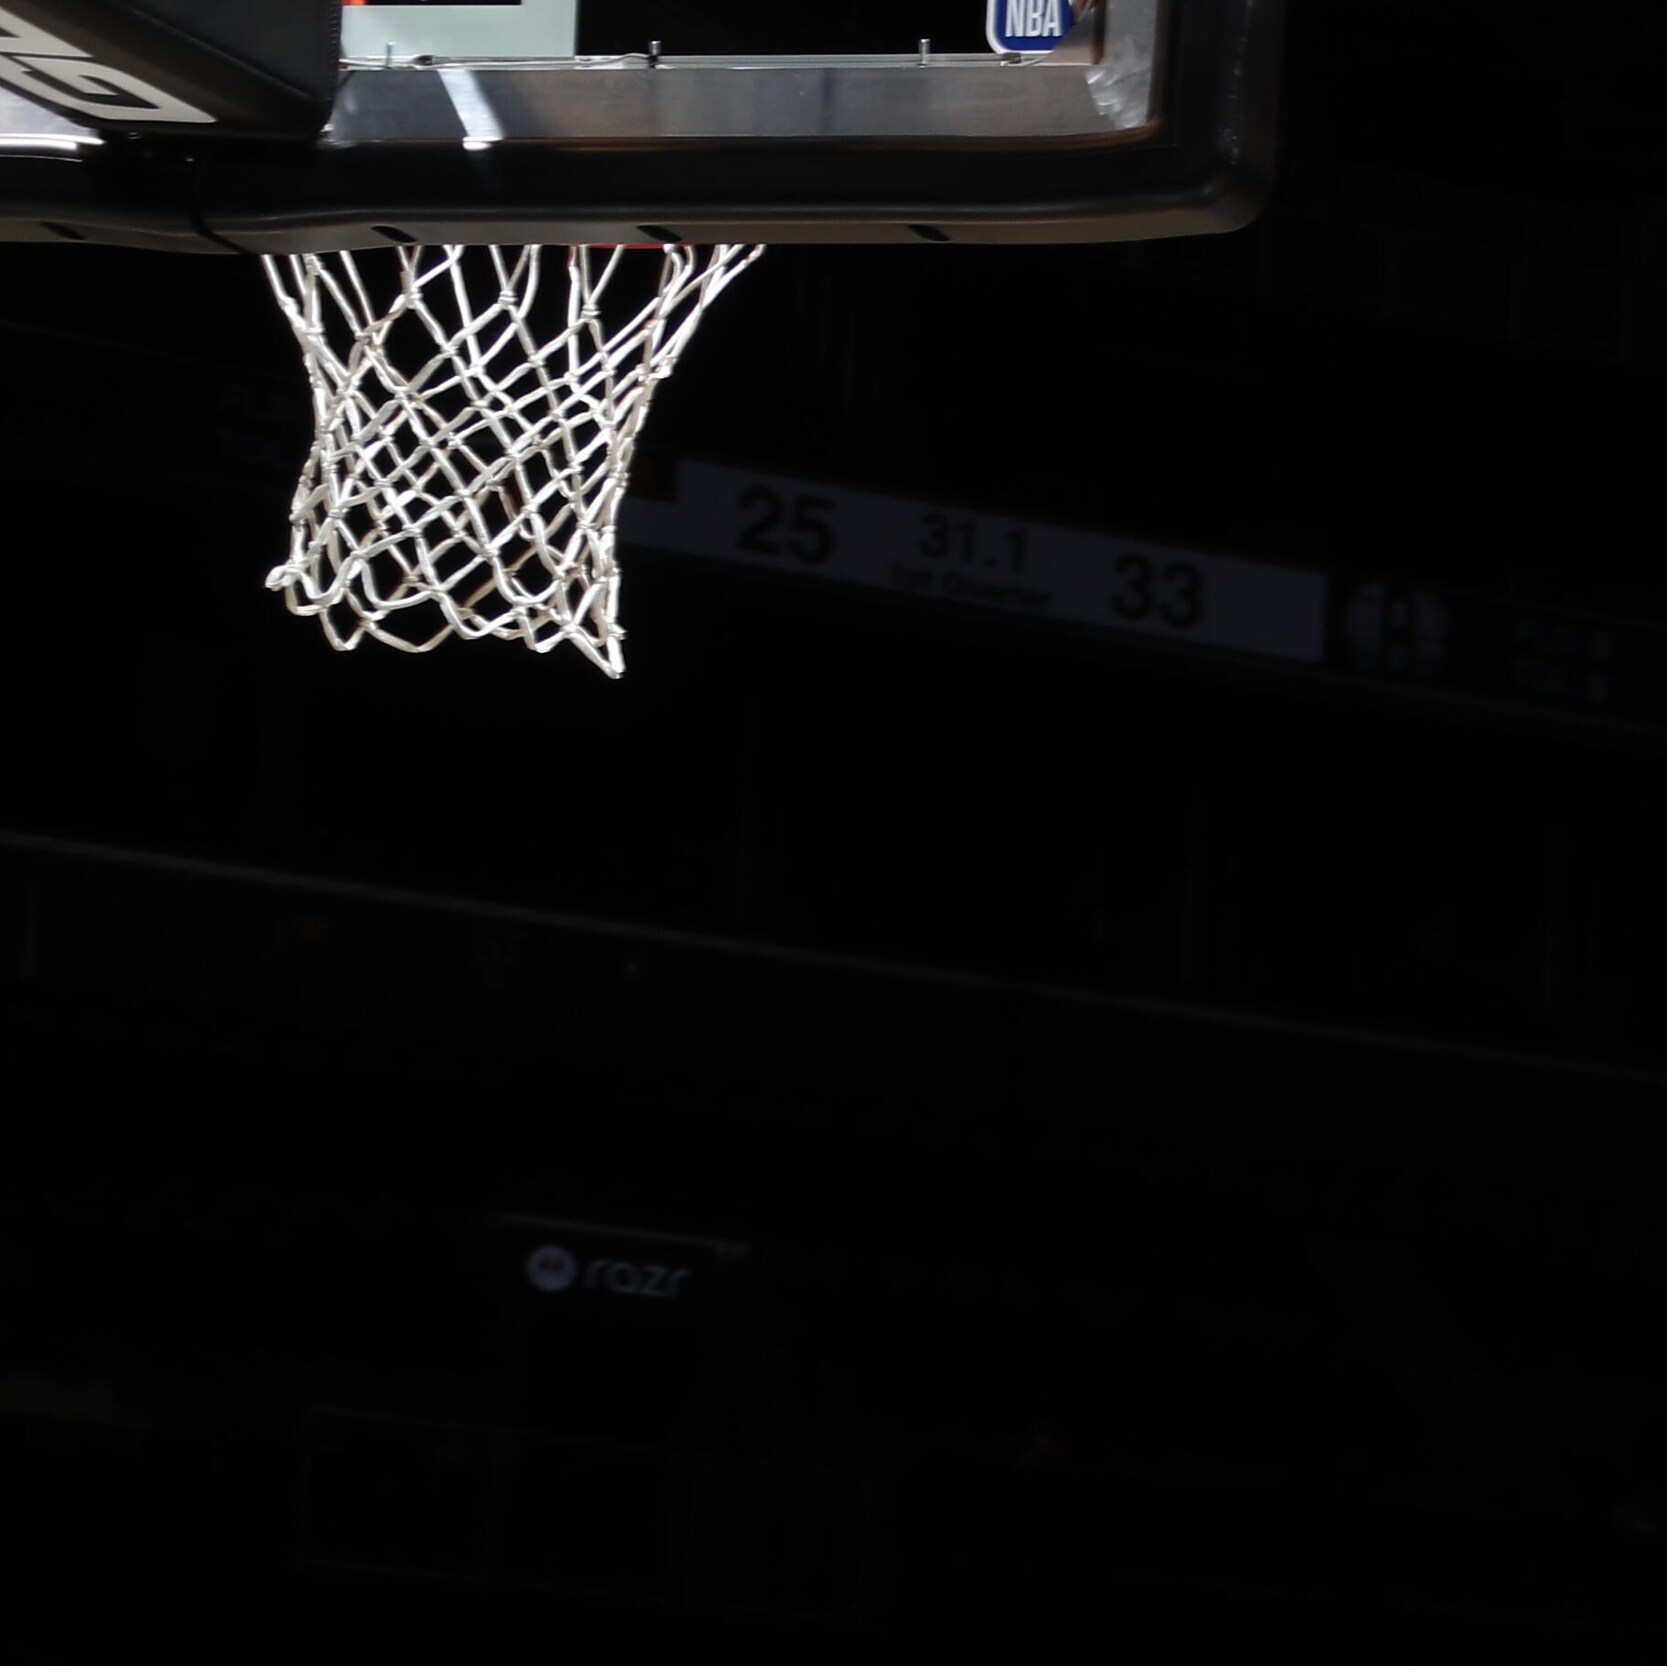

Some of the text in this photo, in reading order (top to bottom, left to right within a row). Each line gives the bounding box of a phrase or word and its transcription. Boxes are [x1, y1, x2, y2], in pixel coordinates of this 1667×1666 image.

[1004, 0, 1063, 38] NBA
[736, 486, 834, 564] 25
[917, 512, 1028, 573] 31.1
[1111, 552, 1203, 629] 33
